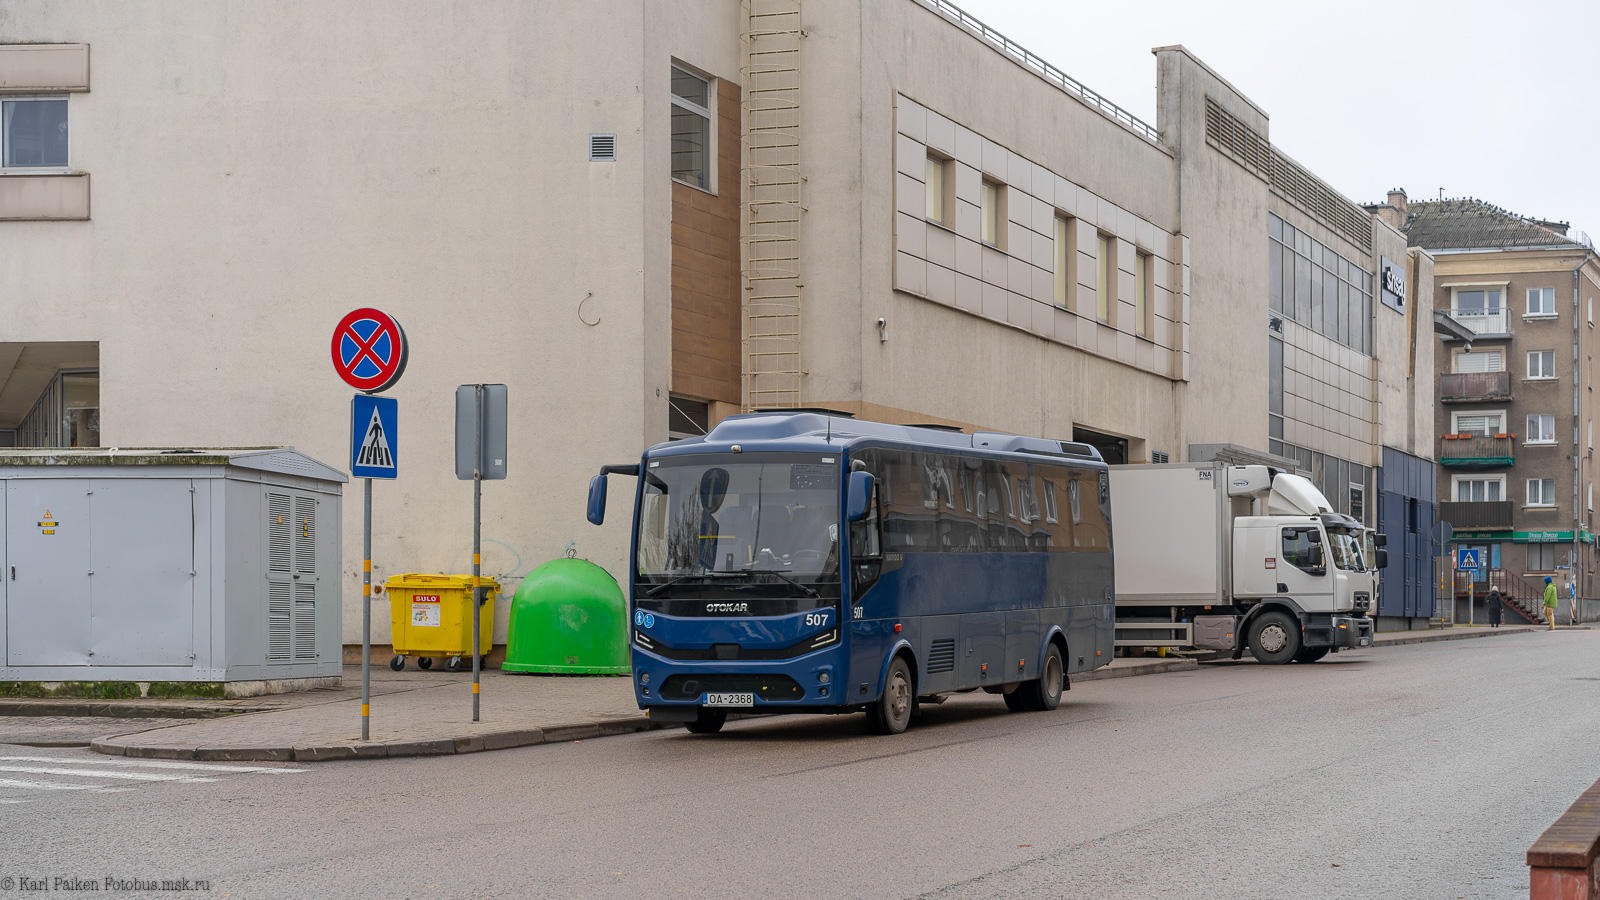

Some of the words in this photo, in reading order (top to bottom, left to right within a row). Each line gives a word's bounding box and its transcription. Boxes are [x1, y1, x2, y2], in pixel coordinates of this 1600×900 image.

[706, 603, 748, 612] OTOKAR
[853, 607, 864, 619] 507
[805, 614, 829, 626] 507
[709, 694, 752, 704] OA-2368
